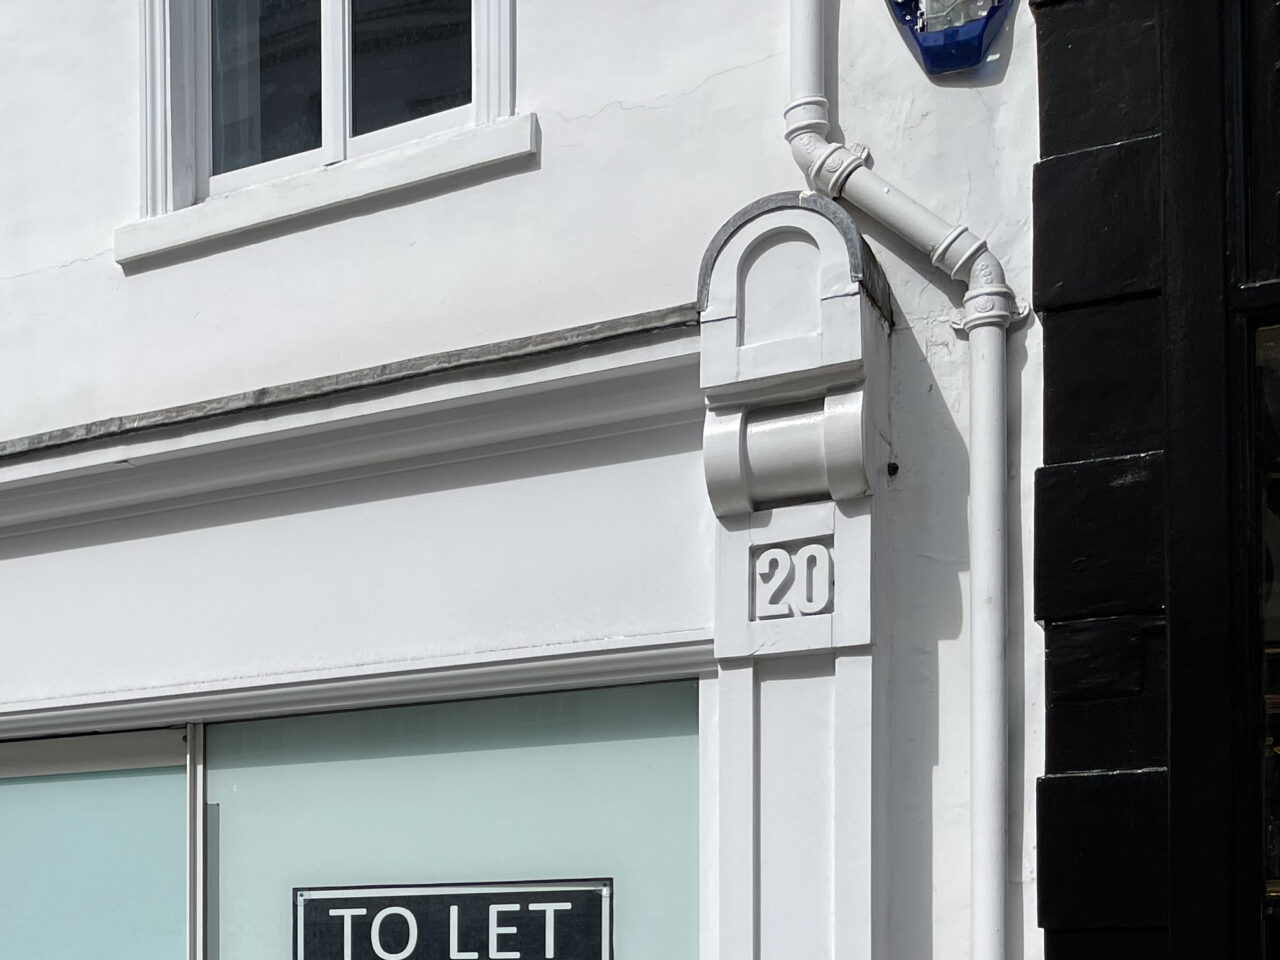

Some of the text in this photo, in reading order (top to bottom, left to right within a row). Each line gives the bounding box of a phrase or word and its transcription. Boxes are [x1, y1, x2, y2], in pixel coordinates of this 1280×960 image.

[755, 543, 830, 618] 20
[329, 902, 572, 960] TO LET
